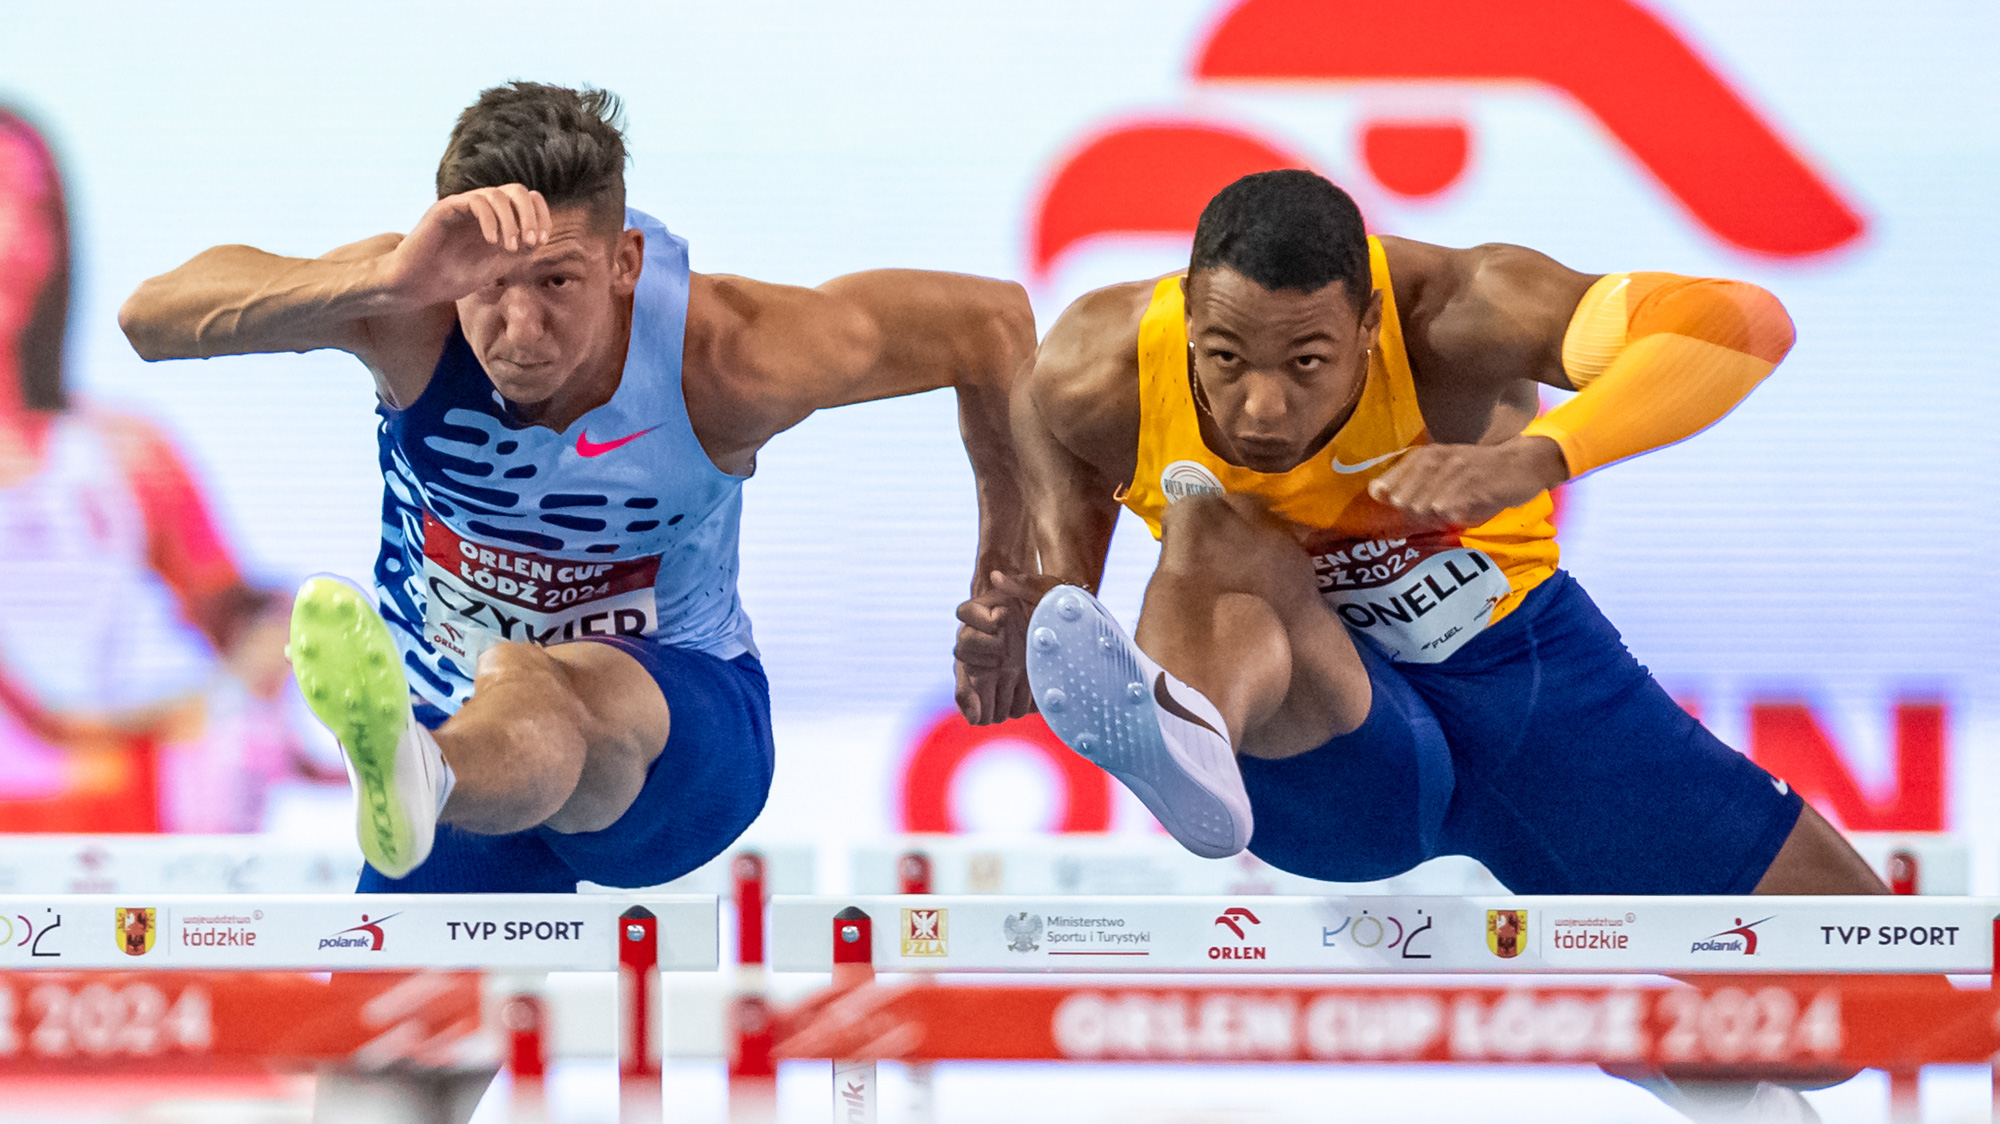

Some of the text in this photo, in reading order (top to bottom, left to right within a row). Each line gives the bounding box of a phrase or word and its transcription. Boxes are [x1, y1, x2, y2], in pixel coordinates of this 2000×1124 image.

[458, 540, 614, 583] ORLEN CUP
[1355, 547, 1420, 584] 2024
[459, 561, 610, 607] ŁÓDŹ 2024
[1337, 551, 1491, 629] ONELLI
[446, 920, 585, 941] TVP SPORT
[1047, 916, 1125, 928] Ministerstwo
[182, 927, 257, 947] łódzkie
[317, 936, 370, 951] polanik
[1047, 931, 1086, 944] Sportu
[1096, 931, 1151, 945] Turystyki
[1554, 930, 1629, 949] łódzkie
[1820, 926, 1960, 946] TVP SPORT
[902, 941, 946, 954] PZLA
[1207, 946, 1267, 960] ORLEN
[1690, 939, 1743, 954] polanik
[28, 983, 212, 1055] 2024
[1052, 993, 1294, 1060] ORLEN
[1307, 993, 1440, 1058] CUP
[1658, 985, 1842, 1060] 2024
